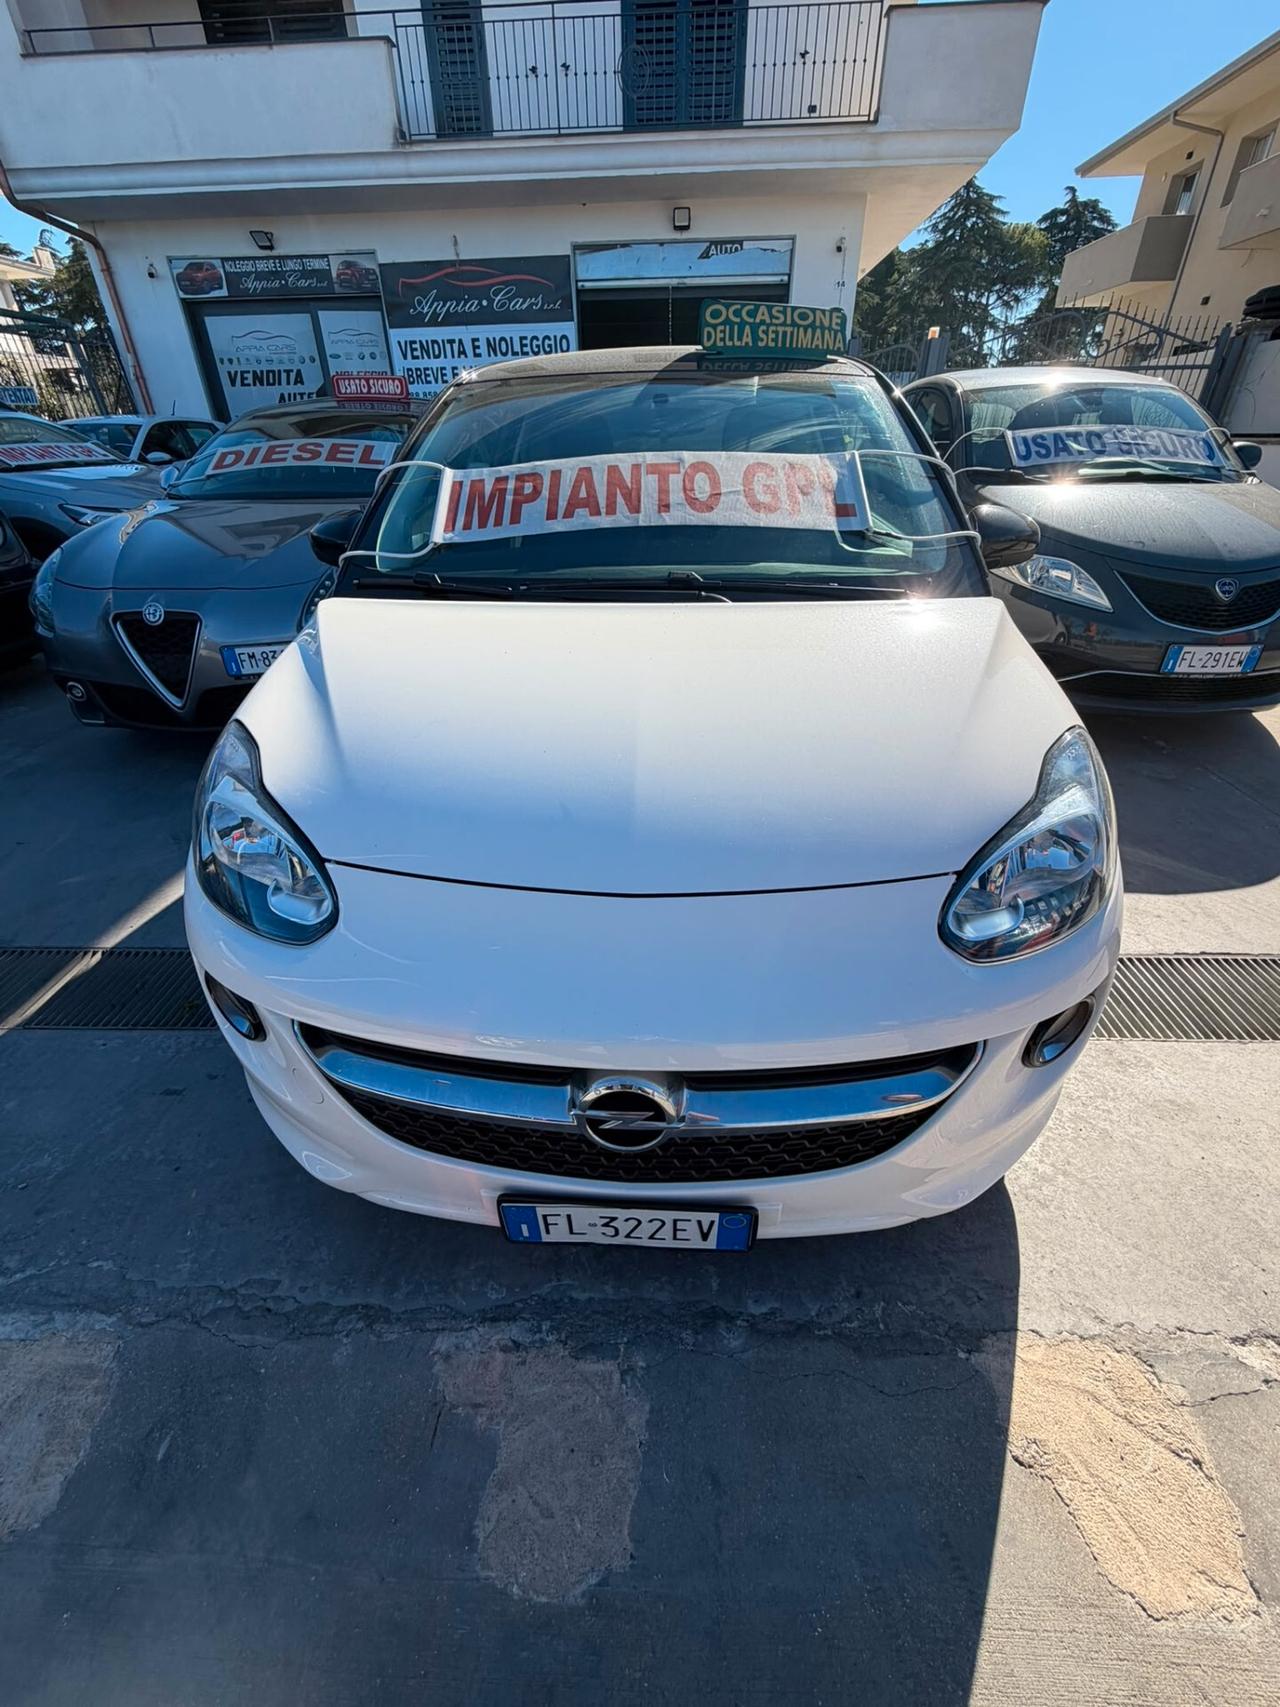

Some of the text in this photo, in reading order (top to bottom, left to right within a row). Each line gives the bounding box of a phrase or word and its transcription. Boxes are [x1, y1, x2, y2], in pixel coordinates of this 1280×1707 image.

[224, 258, 330, 272] NOLEGGIO BREVE E LUNGO TERMINE
[240, 272, 316, 293] Appia Cars
[409, 289, 480, 322] Appia
[490, 285, 543, 311] Cars
[704, 303, 842, 330] OCCASIONE
[397, 334, 571, 361] VENDITA E NOLEGGIO
[703, 325, 844, 351] DELLA SETTIMANA
[227, 368, 305, 387] VENDITA
[338, 379, 401, 394] USATO SICURO
[406, 366, 448, 385] BREVE
[212, 442, 386, 471] DIESEL
[1013, 430, 1107, 462] USATO
[443, 459, 858, 534] IMPIANTO GPL
